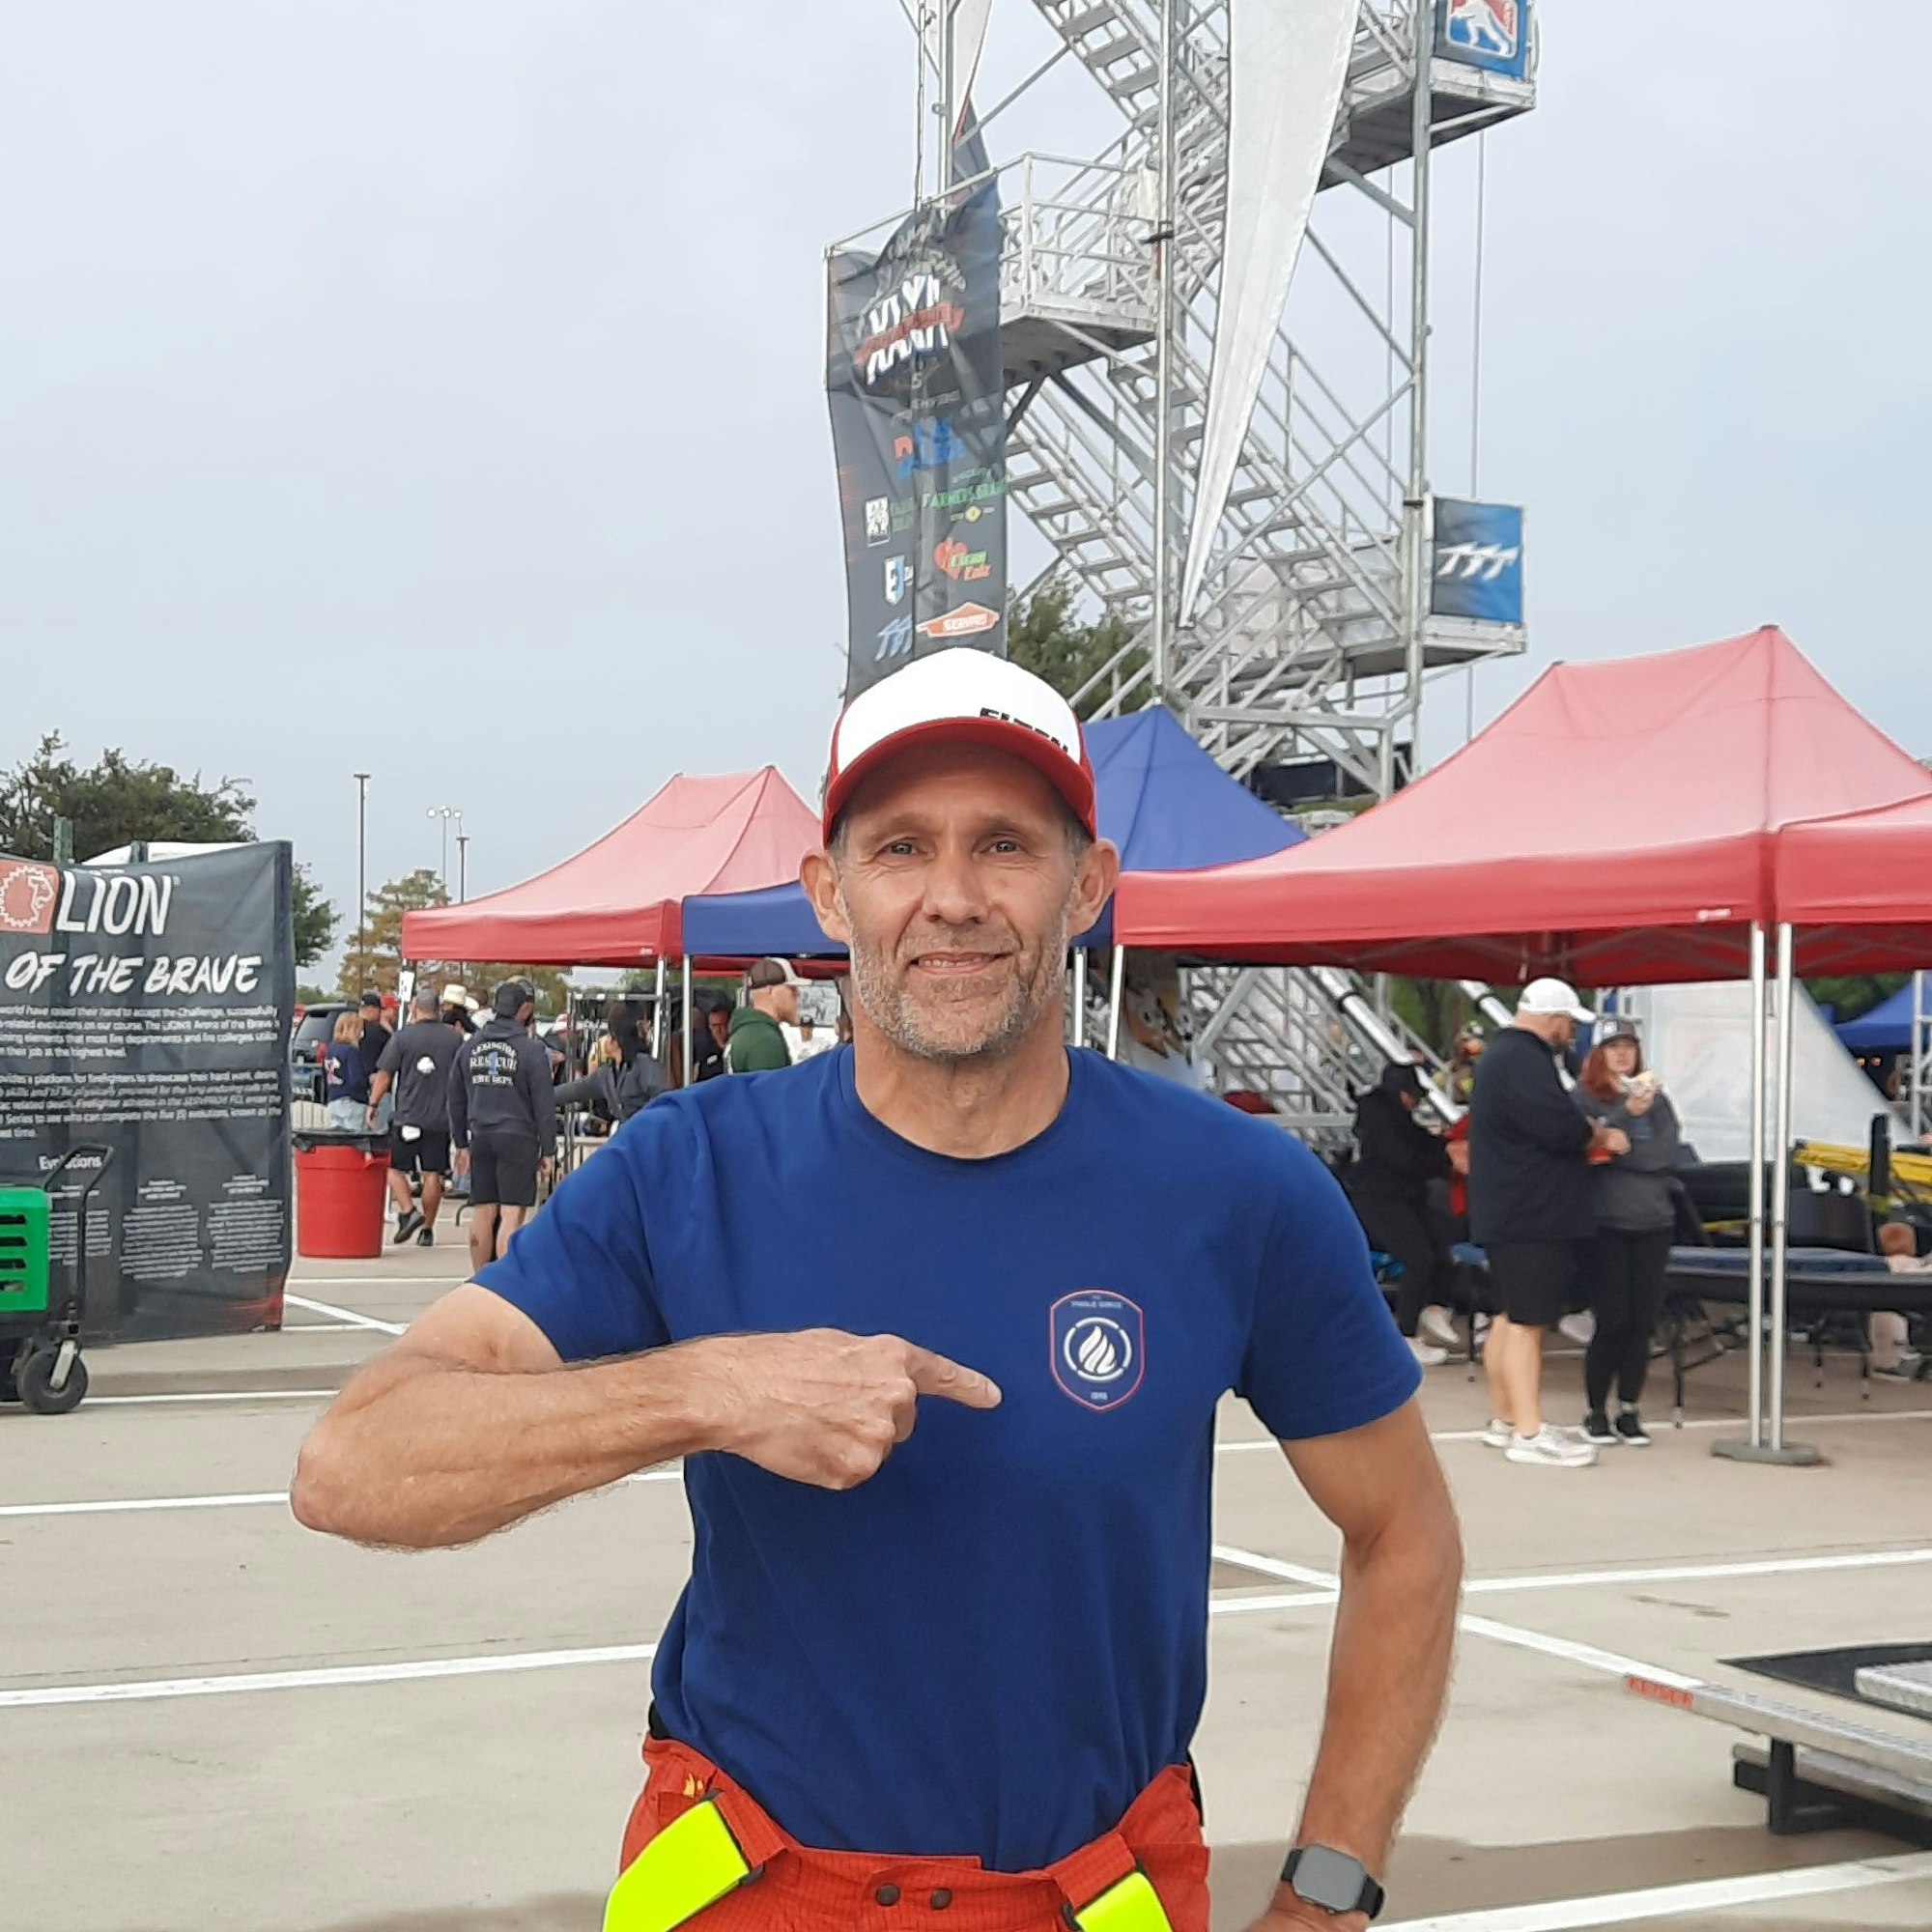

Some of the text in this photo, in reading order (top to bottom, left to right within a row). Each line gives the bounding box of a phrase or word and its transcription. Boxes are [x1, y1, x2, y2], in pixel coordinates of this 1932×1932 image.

[56, 871, 172, 935] LION
[5, 951, 262, 997] OF THE BRAVE
[39, 1153, 102, 1171] Evutions
